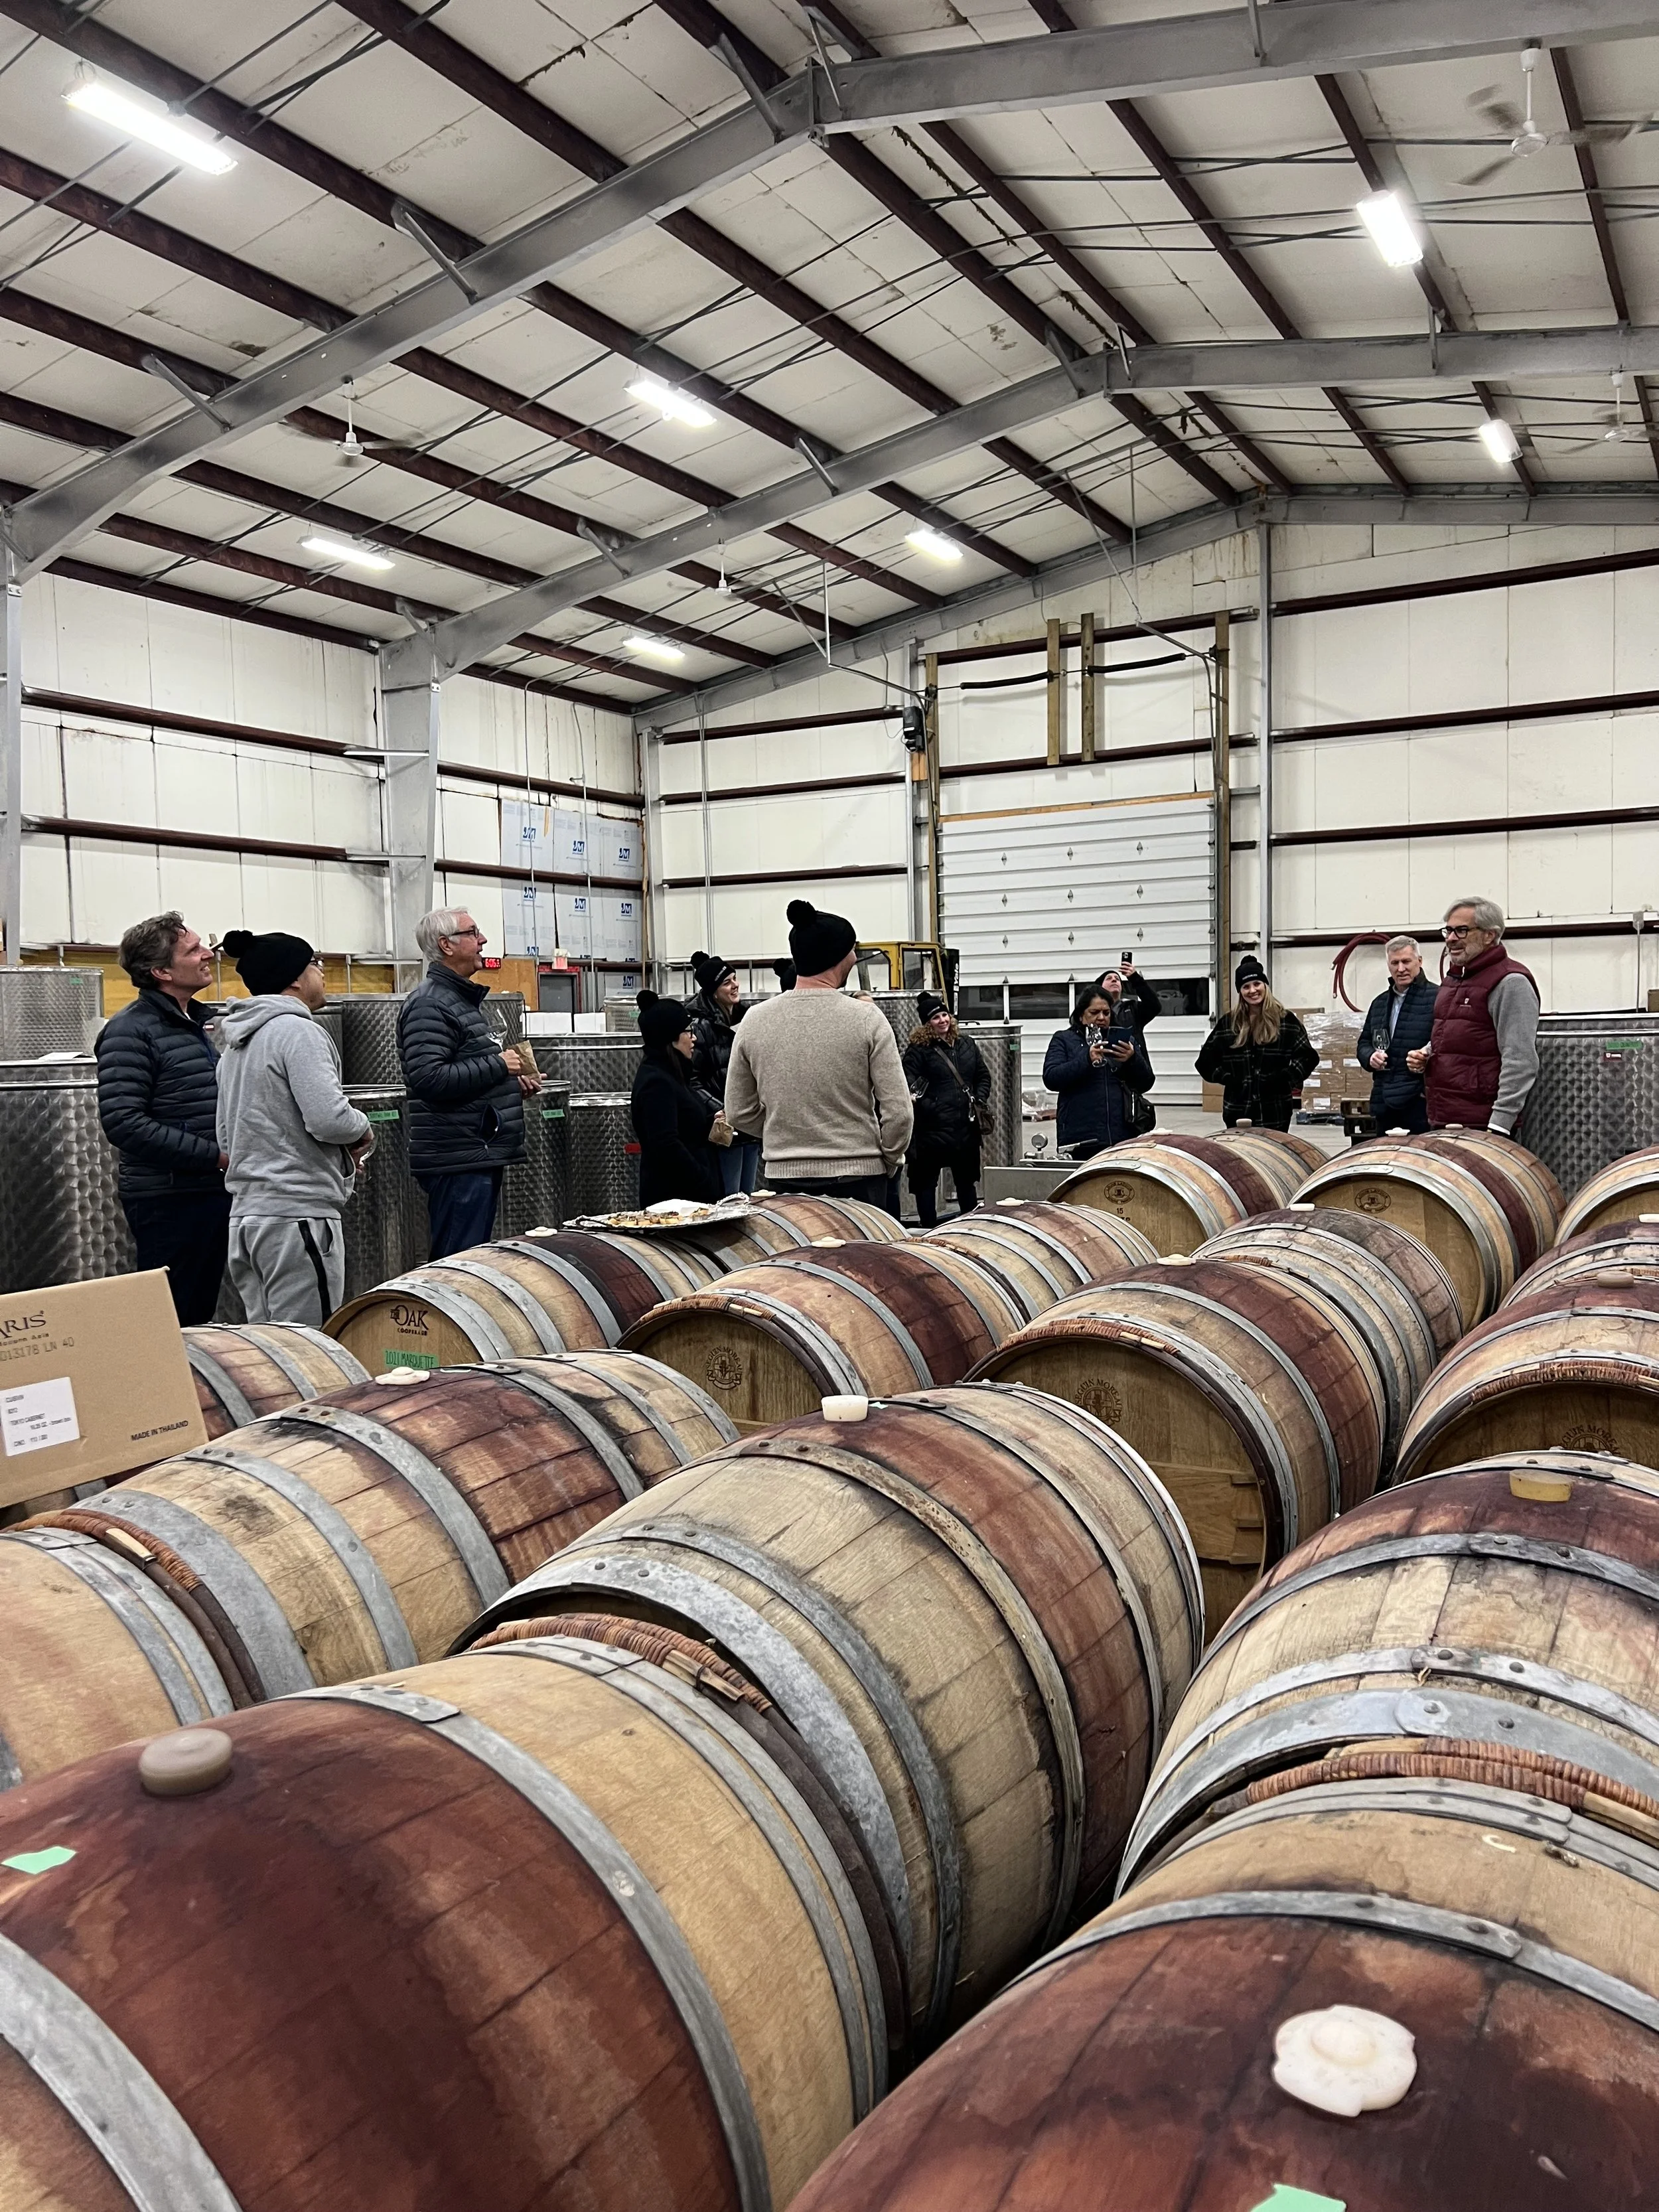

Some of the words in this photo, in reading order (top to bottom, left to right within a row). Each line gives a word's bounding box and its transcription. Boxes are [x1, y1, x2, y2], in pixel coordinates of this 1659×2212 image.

[395, 1305, 429, 1330] OAK
[1075, 1378, 1095, 1404] SEGUIN
[131, 1430, 150, 1441] MADE
[159, 1420, 188, 1434] THAILAND
